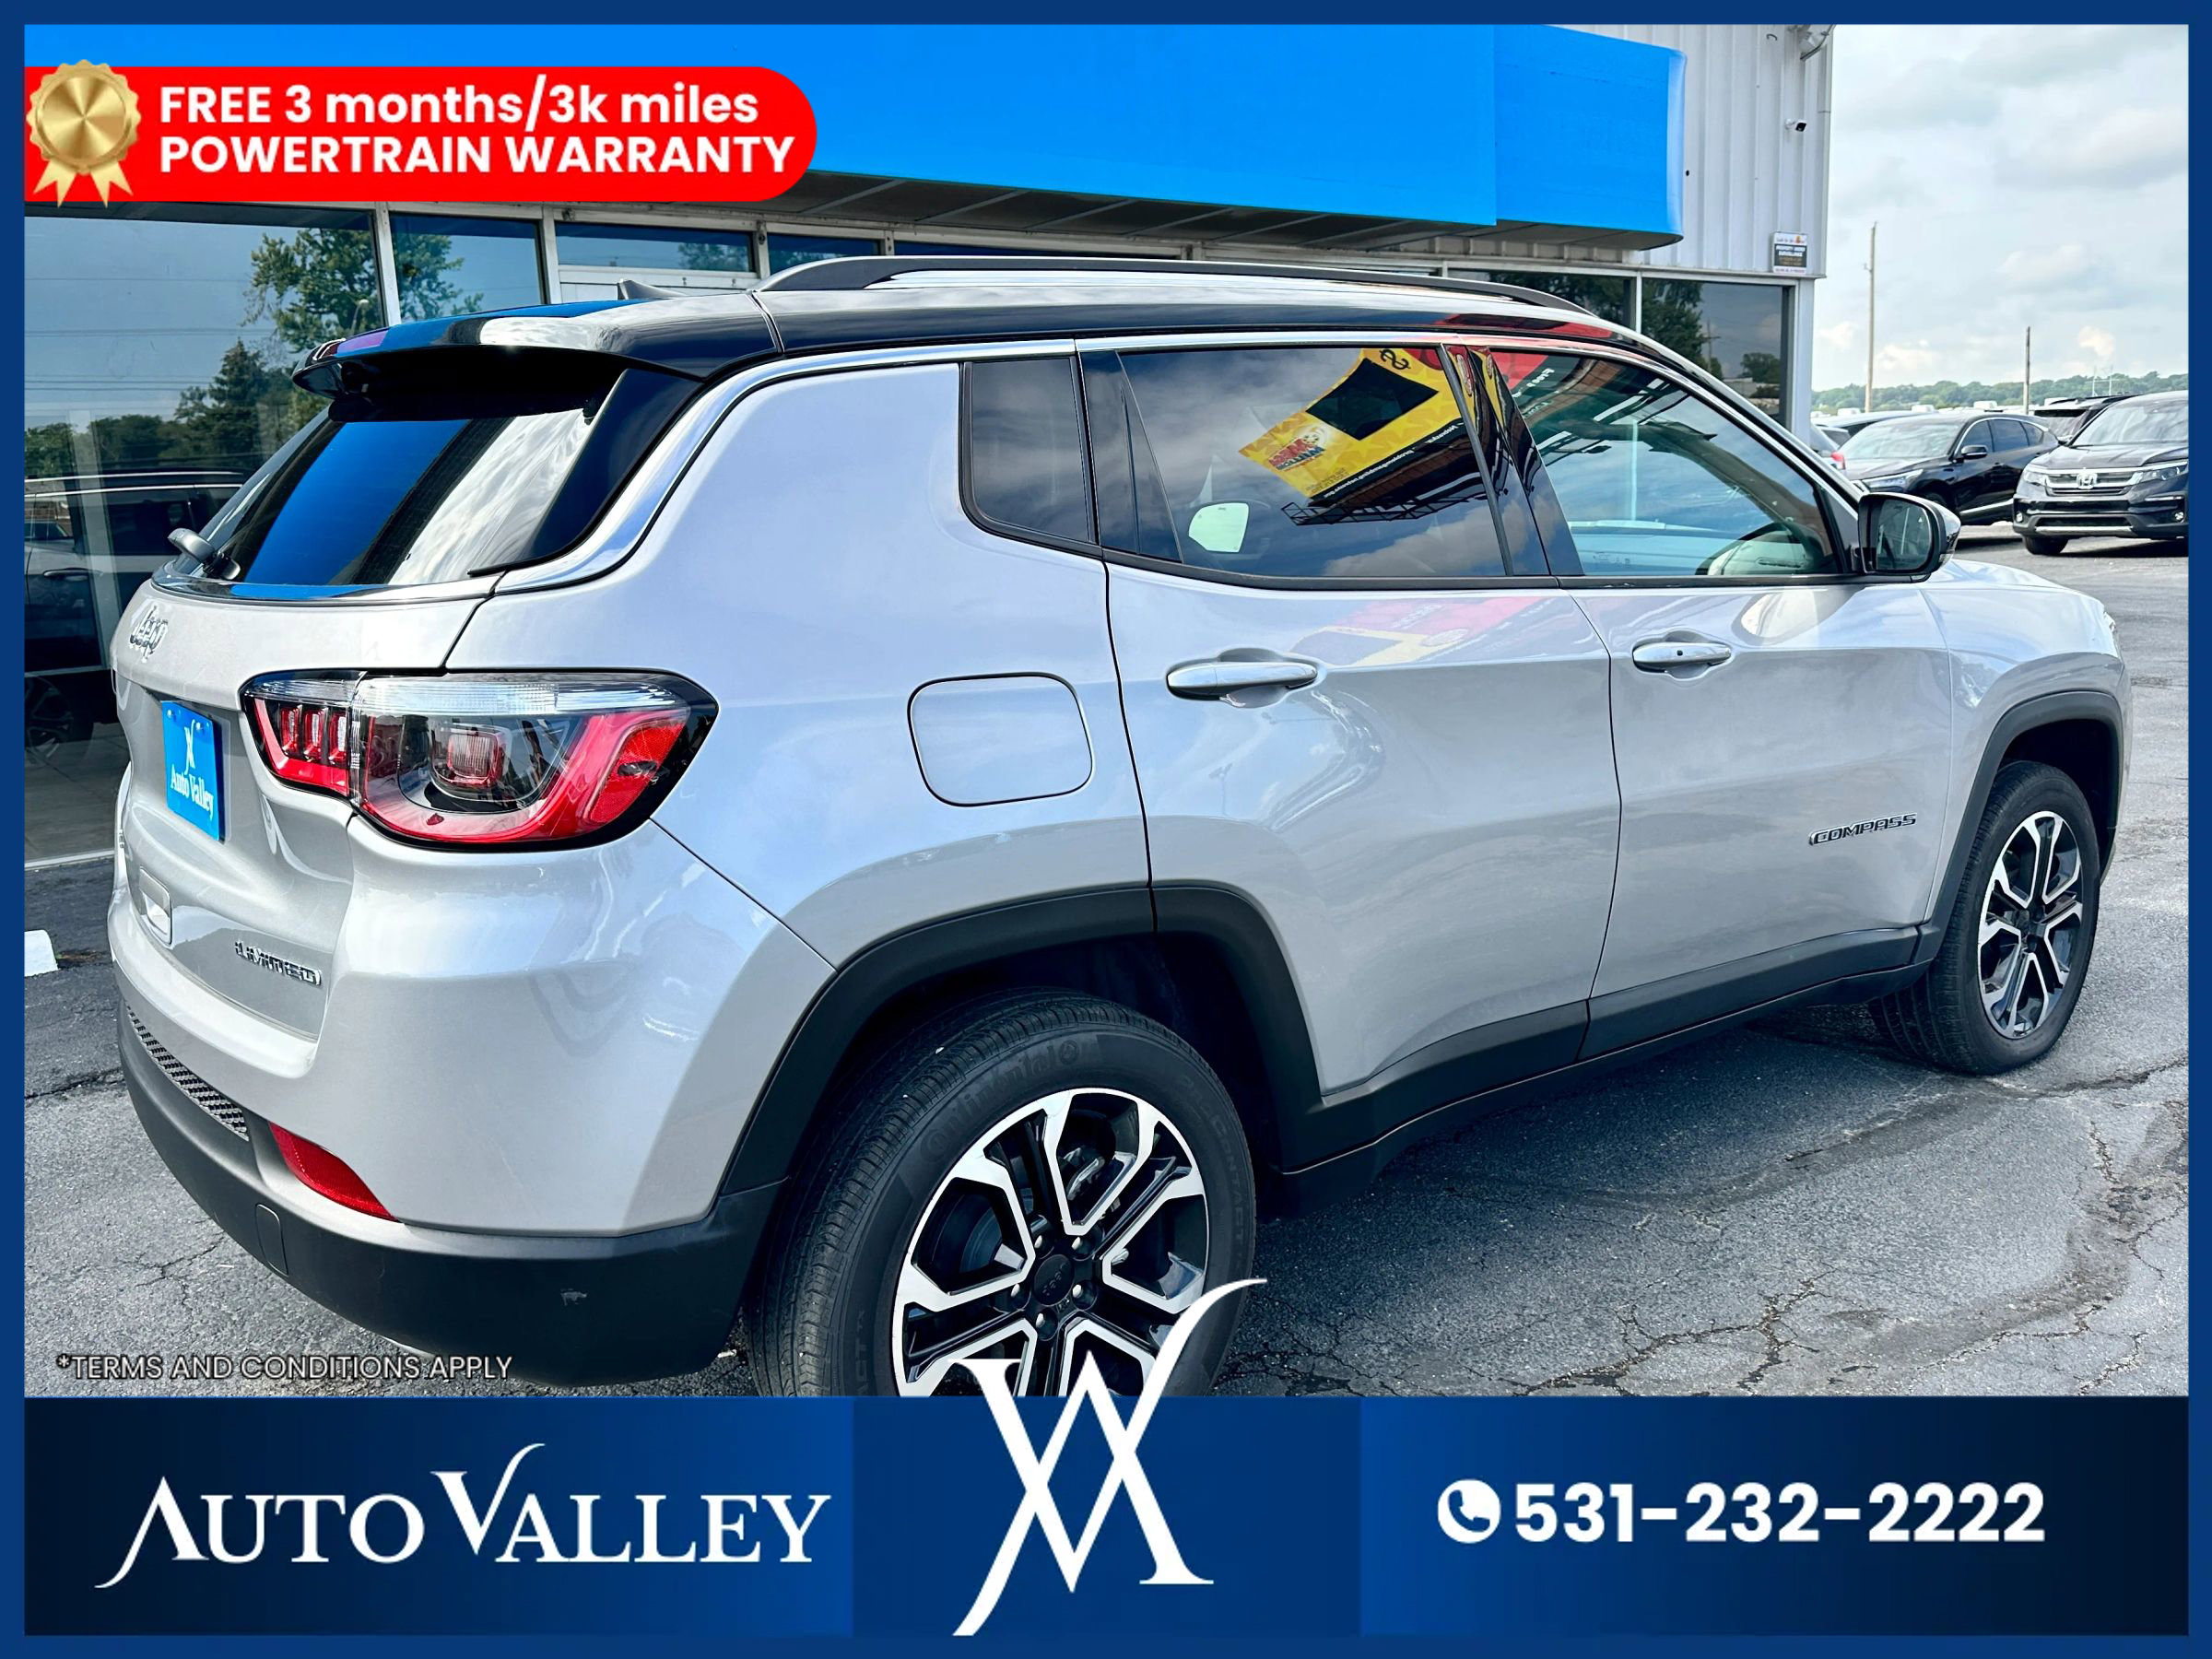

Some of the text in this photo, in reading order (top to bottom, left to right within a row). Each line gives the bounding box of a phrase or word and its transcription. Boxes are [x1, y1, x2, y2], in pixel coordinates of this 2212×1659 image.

[130, 605, 169, 663] Jeep
[170, 763, 215, 821] Auto Valley
[1808, 812, 1918, 846] COMPASS
[235, 938, 323, 986] LIMITED
